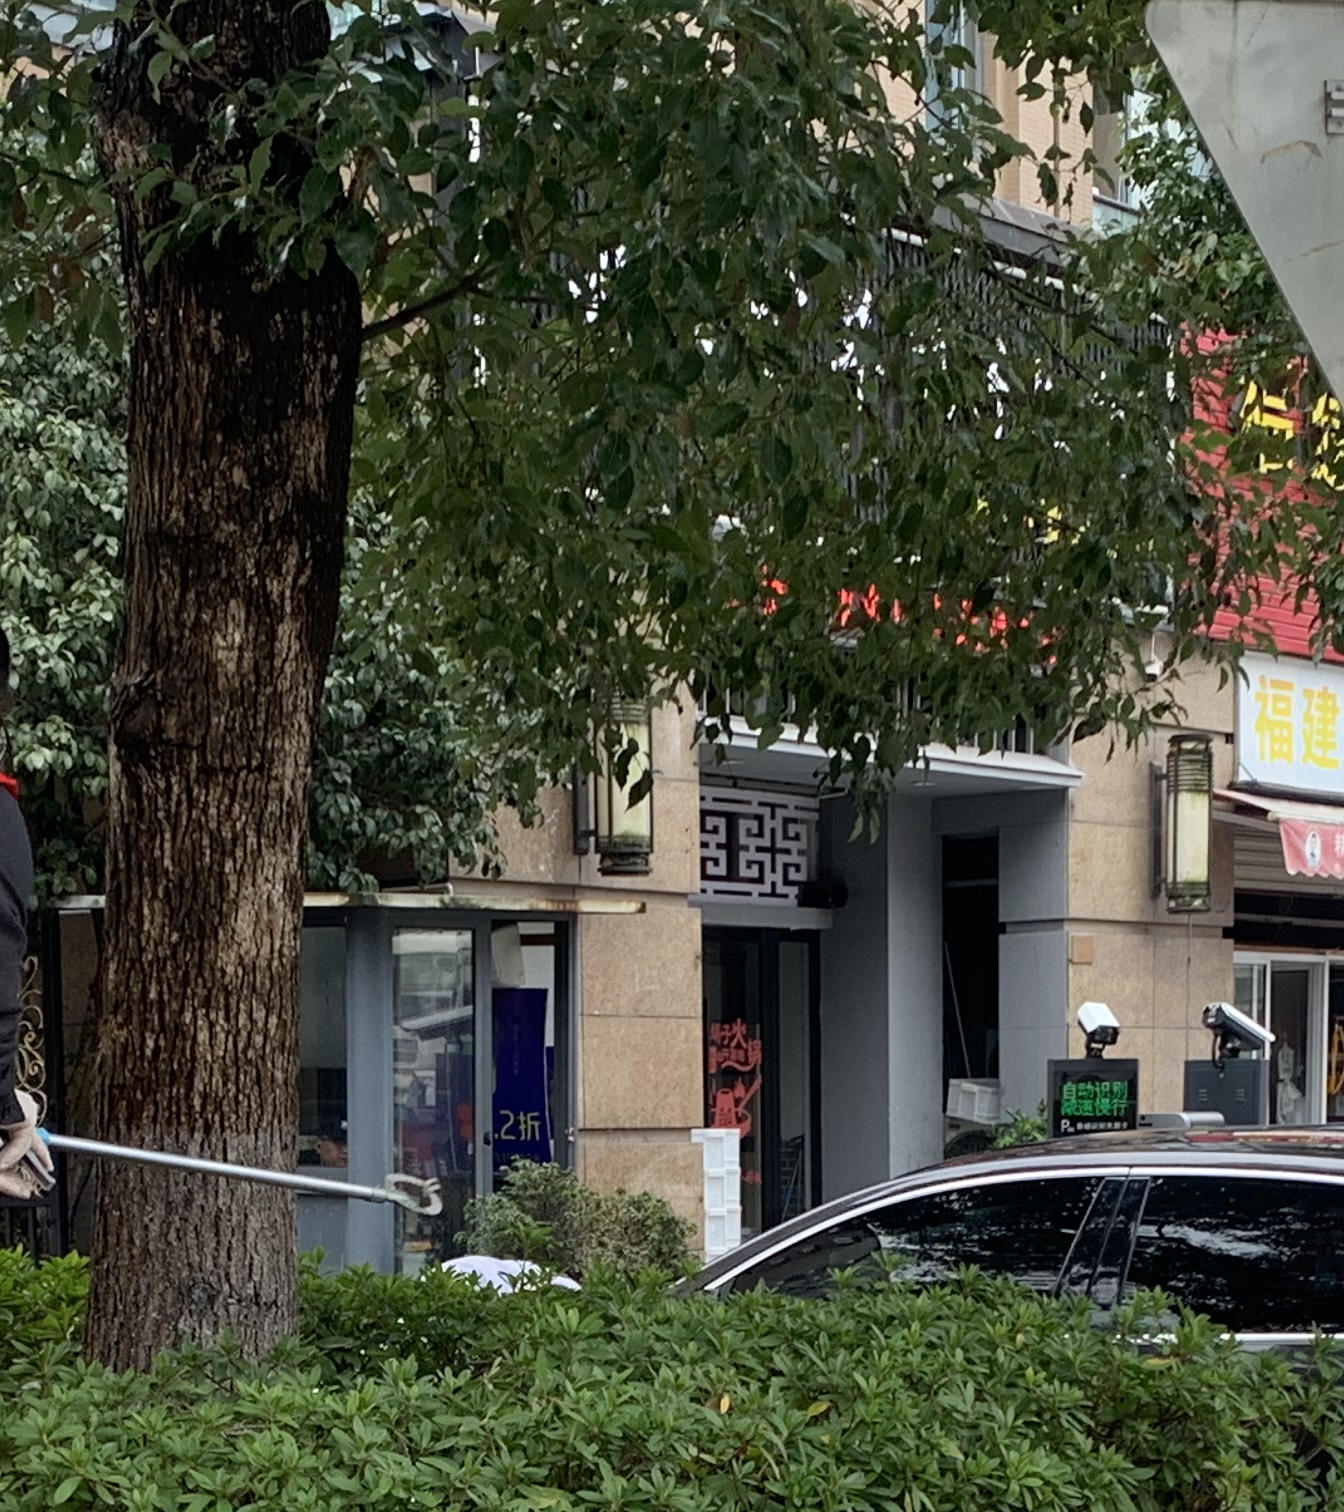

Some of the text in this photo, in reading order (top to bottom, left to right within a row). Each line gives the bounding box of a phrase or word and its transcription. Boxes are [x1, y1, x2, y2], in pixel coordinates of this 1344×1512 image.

[1063, 1081, 1128, 1099] 自动识别
[1061, 1098, 1128, 1117] 减速慢行
